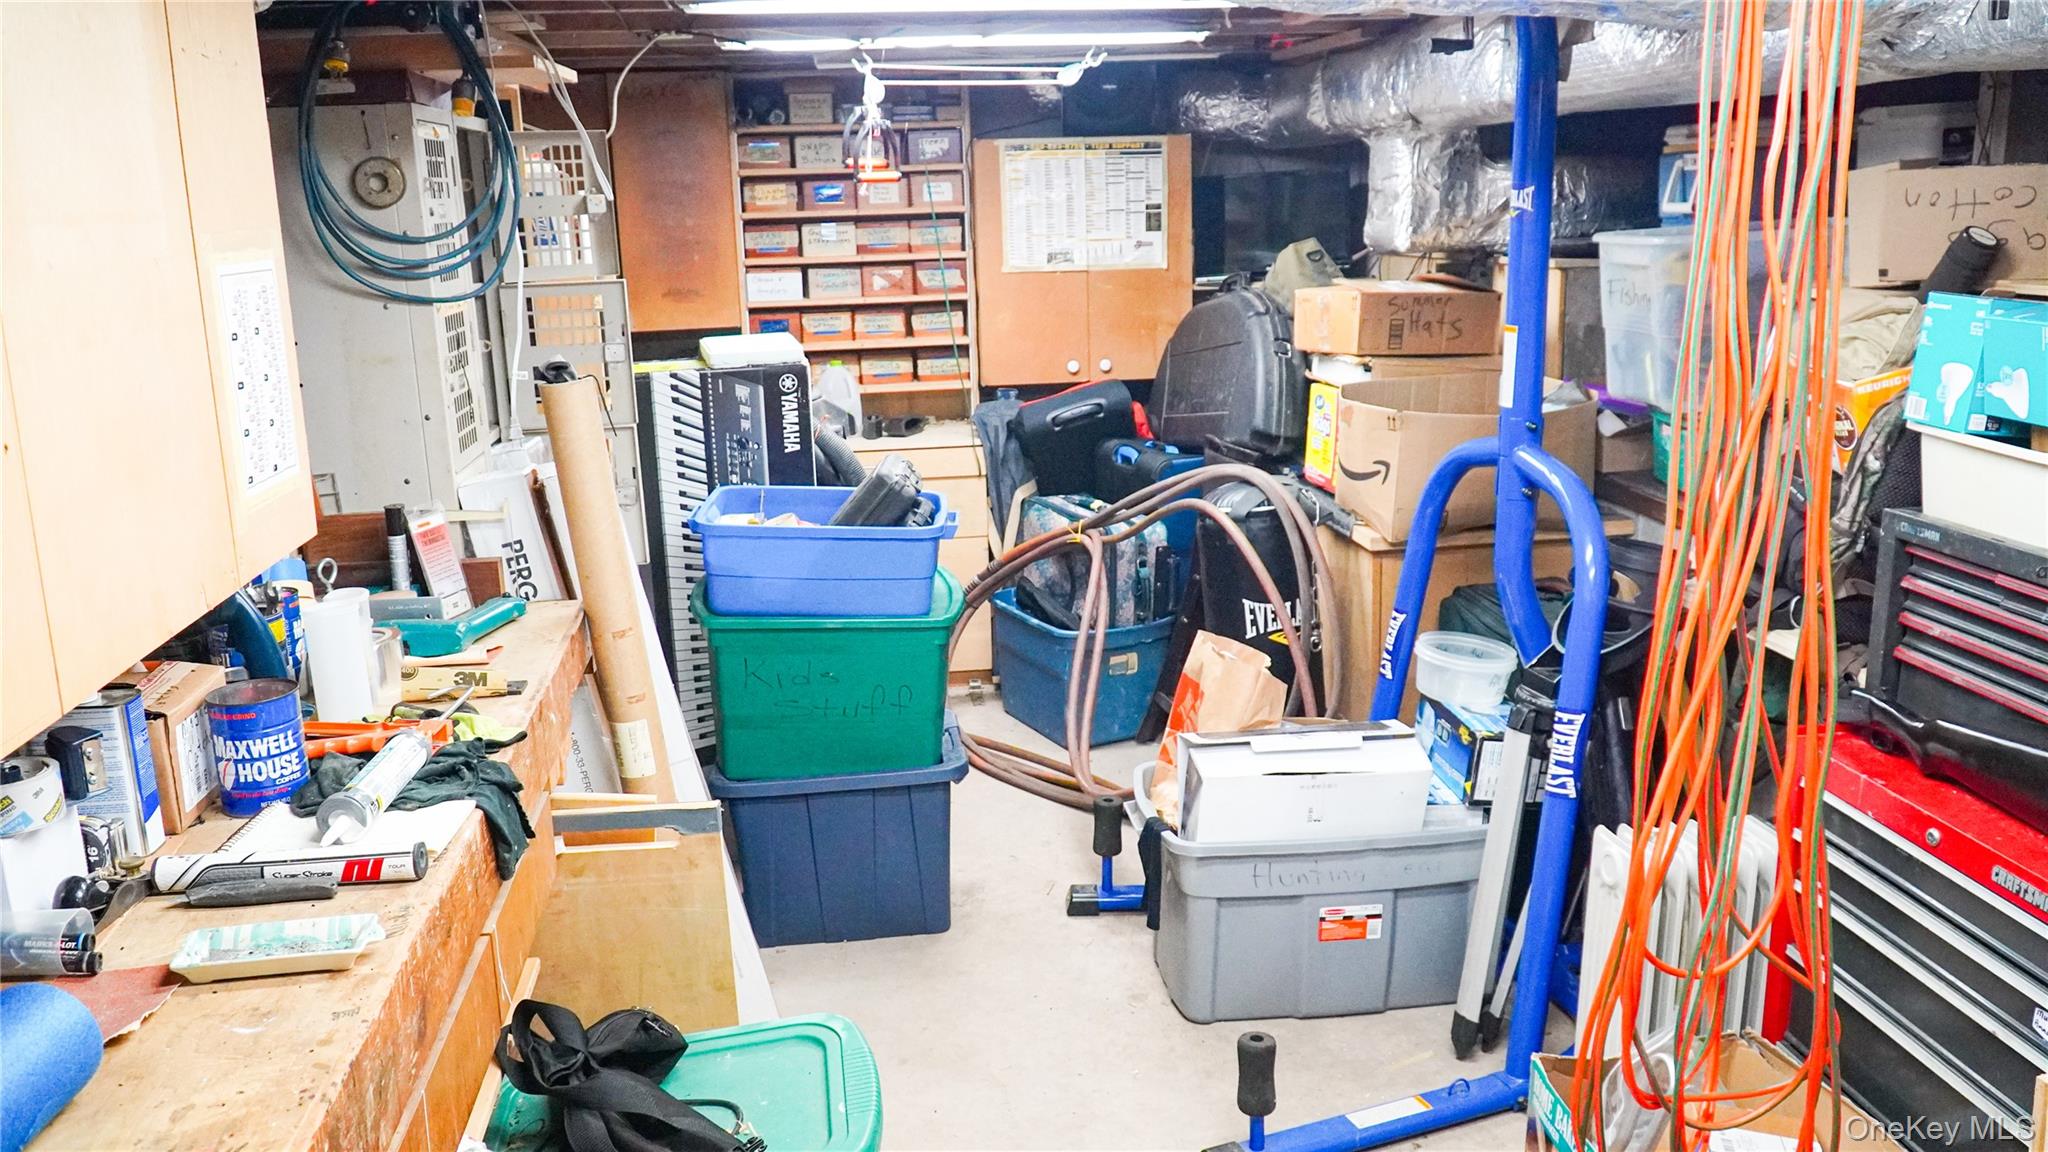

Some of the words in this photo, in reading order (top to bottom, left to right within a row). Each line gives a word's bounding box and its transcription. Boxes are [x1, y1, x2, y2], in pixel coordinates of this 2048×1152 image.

[1410, 310, 1462, 341] Hats
[781, 392, 800, 453] YAMAHA
[453, 671, 488, 686] 3M
[213, 729, 298, 759] MAXWELL
[1545, 711, 1587, 799] EVERLAST
[237, 752, 301, 783] HOUSE
